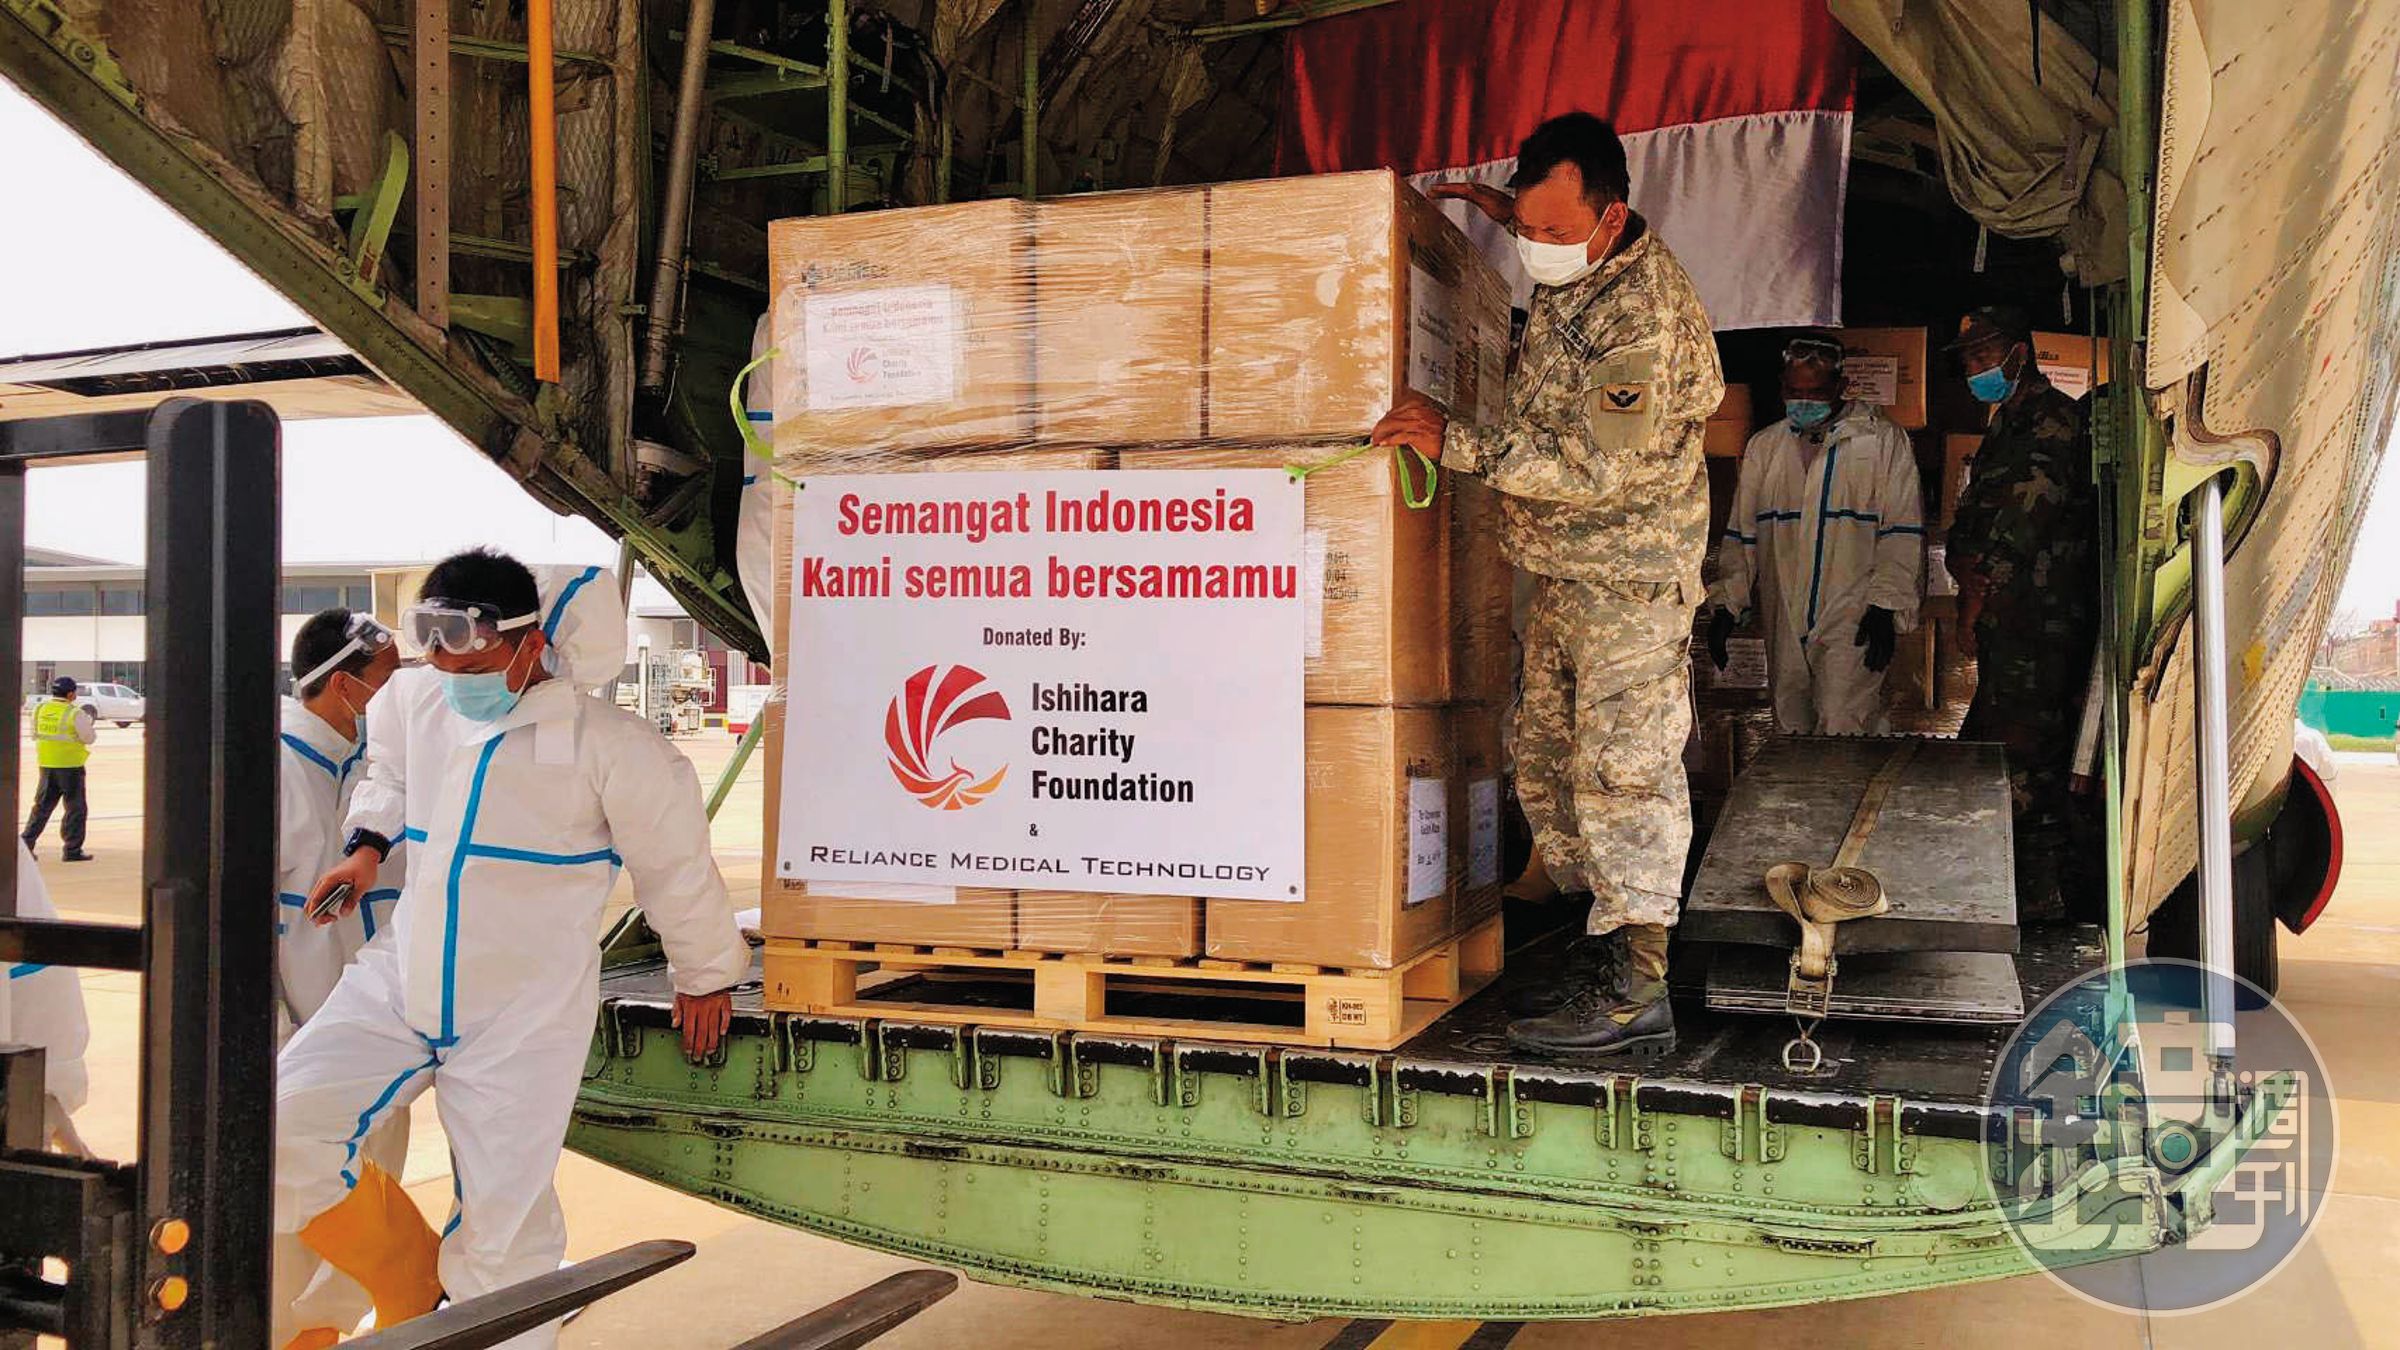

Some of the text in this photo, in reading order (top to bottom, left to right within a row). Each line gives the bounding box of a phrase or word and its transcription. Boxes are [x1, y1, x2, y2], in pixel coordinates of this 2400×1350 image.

[838, 488, 1254, 543] Semangat Indonesia
[802, 556, 891, 598] Kami
[905, 565, 1032, 598] semua
[1048, 556, 1297, 599] bersamamu
[983, 627, 1087, 650] Donated By:
[1032, 682, 1148, 713] Ishihara
[1031, 726, 1136, 764] Charity
[1031, 769, 1194, 803] Foundation
[1029, 823, 1039, 837] &
[810, 845, 1271, 882] RELIANCE MEDICAL TECHNOLOGY
